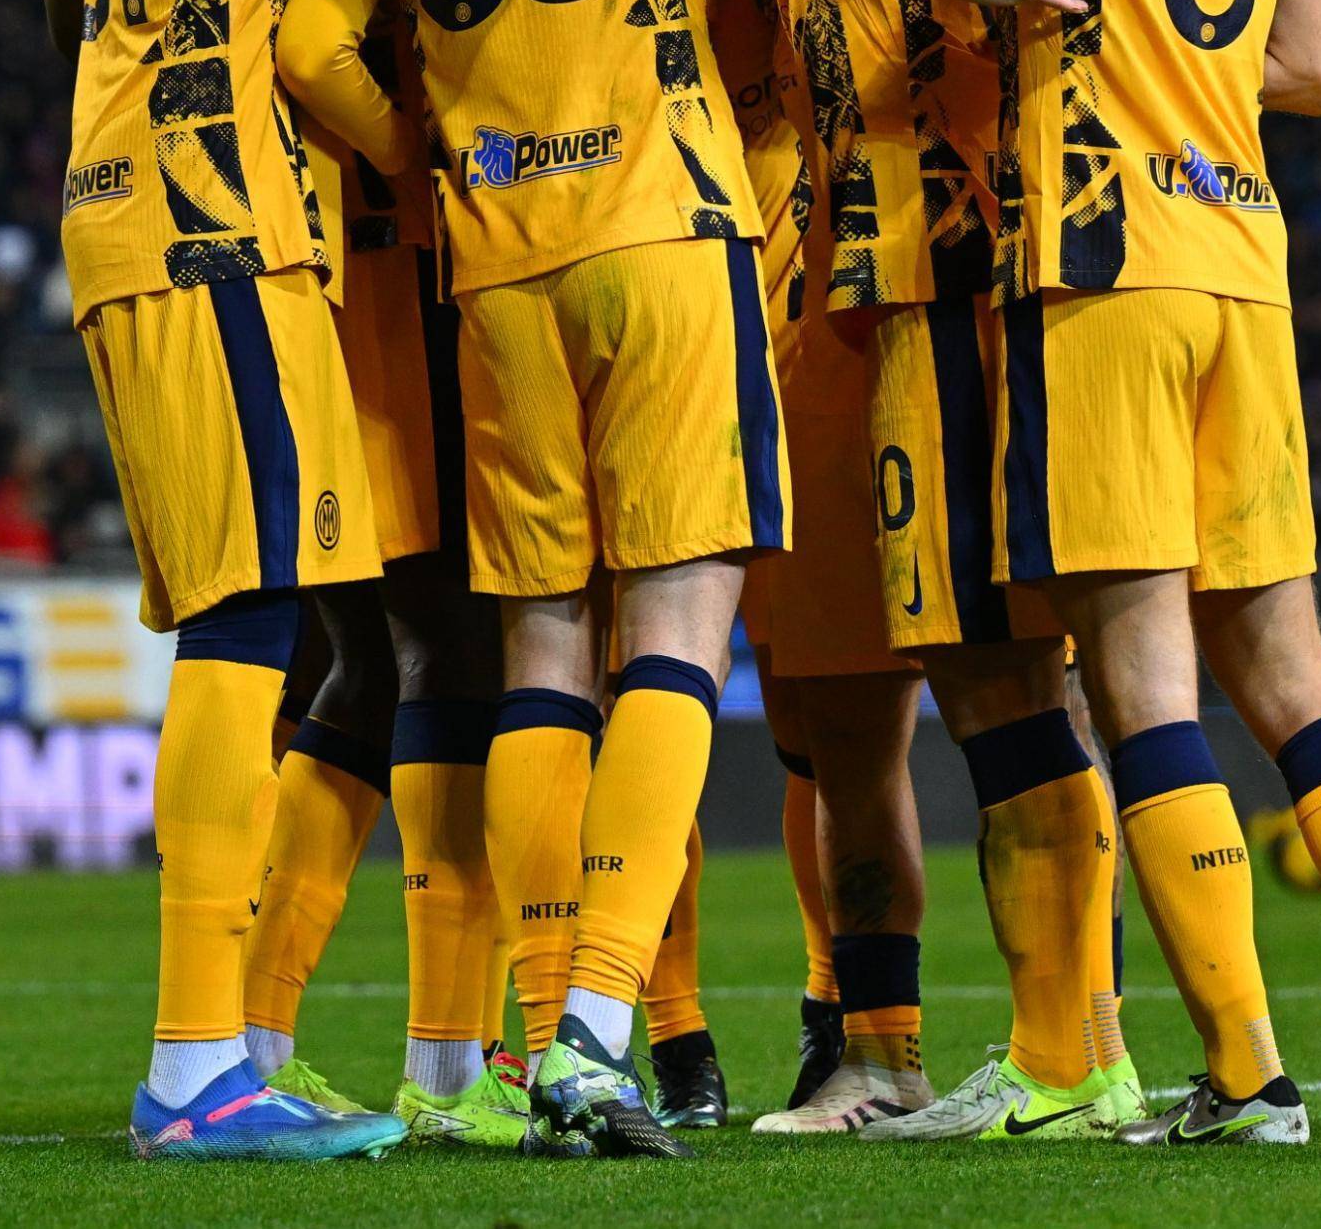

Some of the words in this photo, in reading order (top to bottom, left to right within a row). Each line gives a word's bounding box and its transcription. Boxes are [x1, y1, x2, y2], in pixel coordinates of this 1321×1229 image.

[69, 160, 131, 201] ower
[581, 855, 624, 875] NTER
[1191, 846, 1247, 871] INTER
[403, 873, 429, 891] TER
[521, 901, 579, 920] INTER
